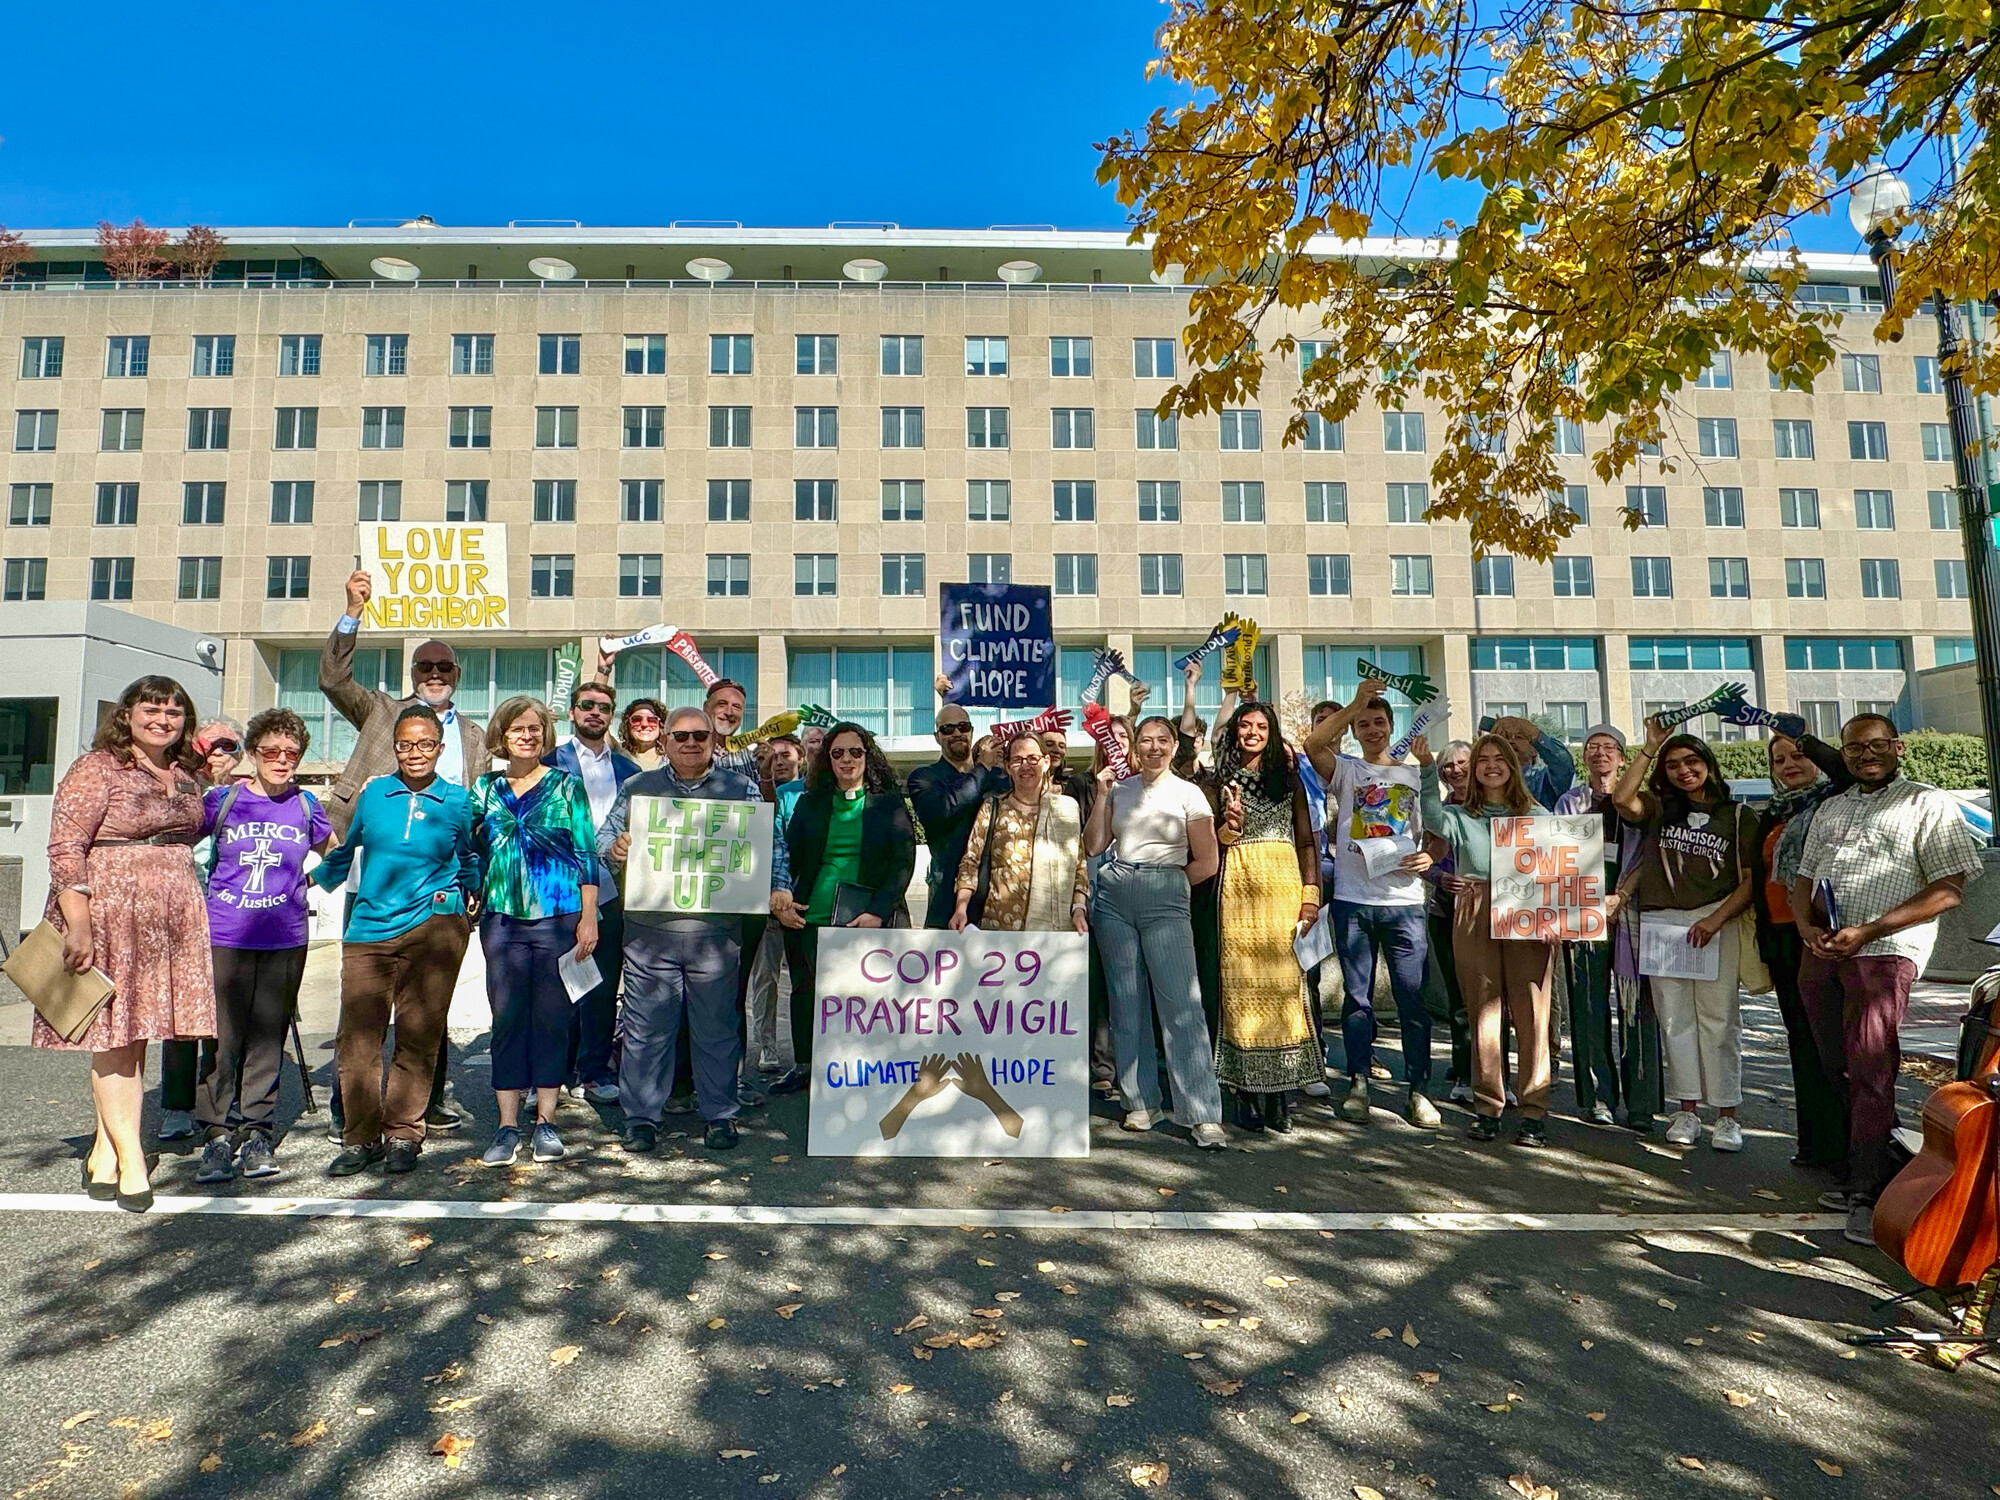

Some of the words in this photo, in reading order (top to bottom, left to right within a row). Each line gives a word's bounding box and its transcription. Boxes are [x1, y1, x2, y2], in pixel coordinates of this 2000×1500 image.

[377, 526, 485, 560] LOVE
[381, 561, 489, 595] YOUR
[363, 595, 507, 628] NEIGHBOR
[960, 602, 1031, 633] FUND
[950, 637, 1045, 663] CLIMATE
[1185, 634, 1229, 666] HINDU
[551, 658, 577, 712] CATHOLIC
[969, 669, 1028, 698] HOPE
[1081, 658, 1115, 703] CHRISTIAN
[1358, 661, 1414, 694] JEWISH
[729, 721, 783, 749] METHODIST
[999, 715, 1059, 740] MUSLIM
[1390, 712, 1430, 760] MENNONITE
[1091, 719, 1131, 778] LUTHERANS
[225, 821, 306, 844] MERCY
[648, 799, 756, 838] LIFT
[1493, 817, 1535, 848] WE
[1658, 837, 1691, 854] JUSTICE
[1660, 824, 1730, 853] FRANCISCAN
[647, 837, 751, 874] THEM
[1514, 846, 1579, 876] OWE
[217, 888, 237, 905] for
[236, 893, 288, 909] Justice
[673, 874, 726, 909] UP
[1536, 876, 1601, 907] THE
[1491, 907, 1605, 939] WORLD
[860, 948, 959, 985] COP
[978, 950, 1042, 987] 29
[820, 996, 963, 1036] PRAYER
[973, 999, 1079, 1035] VIGIL
[826, 1058, 921, 1088] CLIMATE
[991, 1057, 1056, 1086] HOPE
